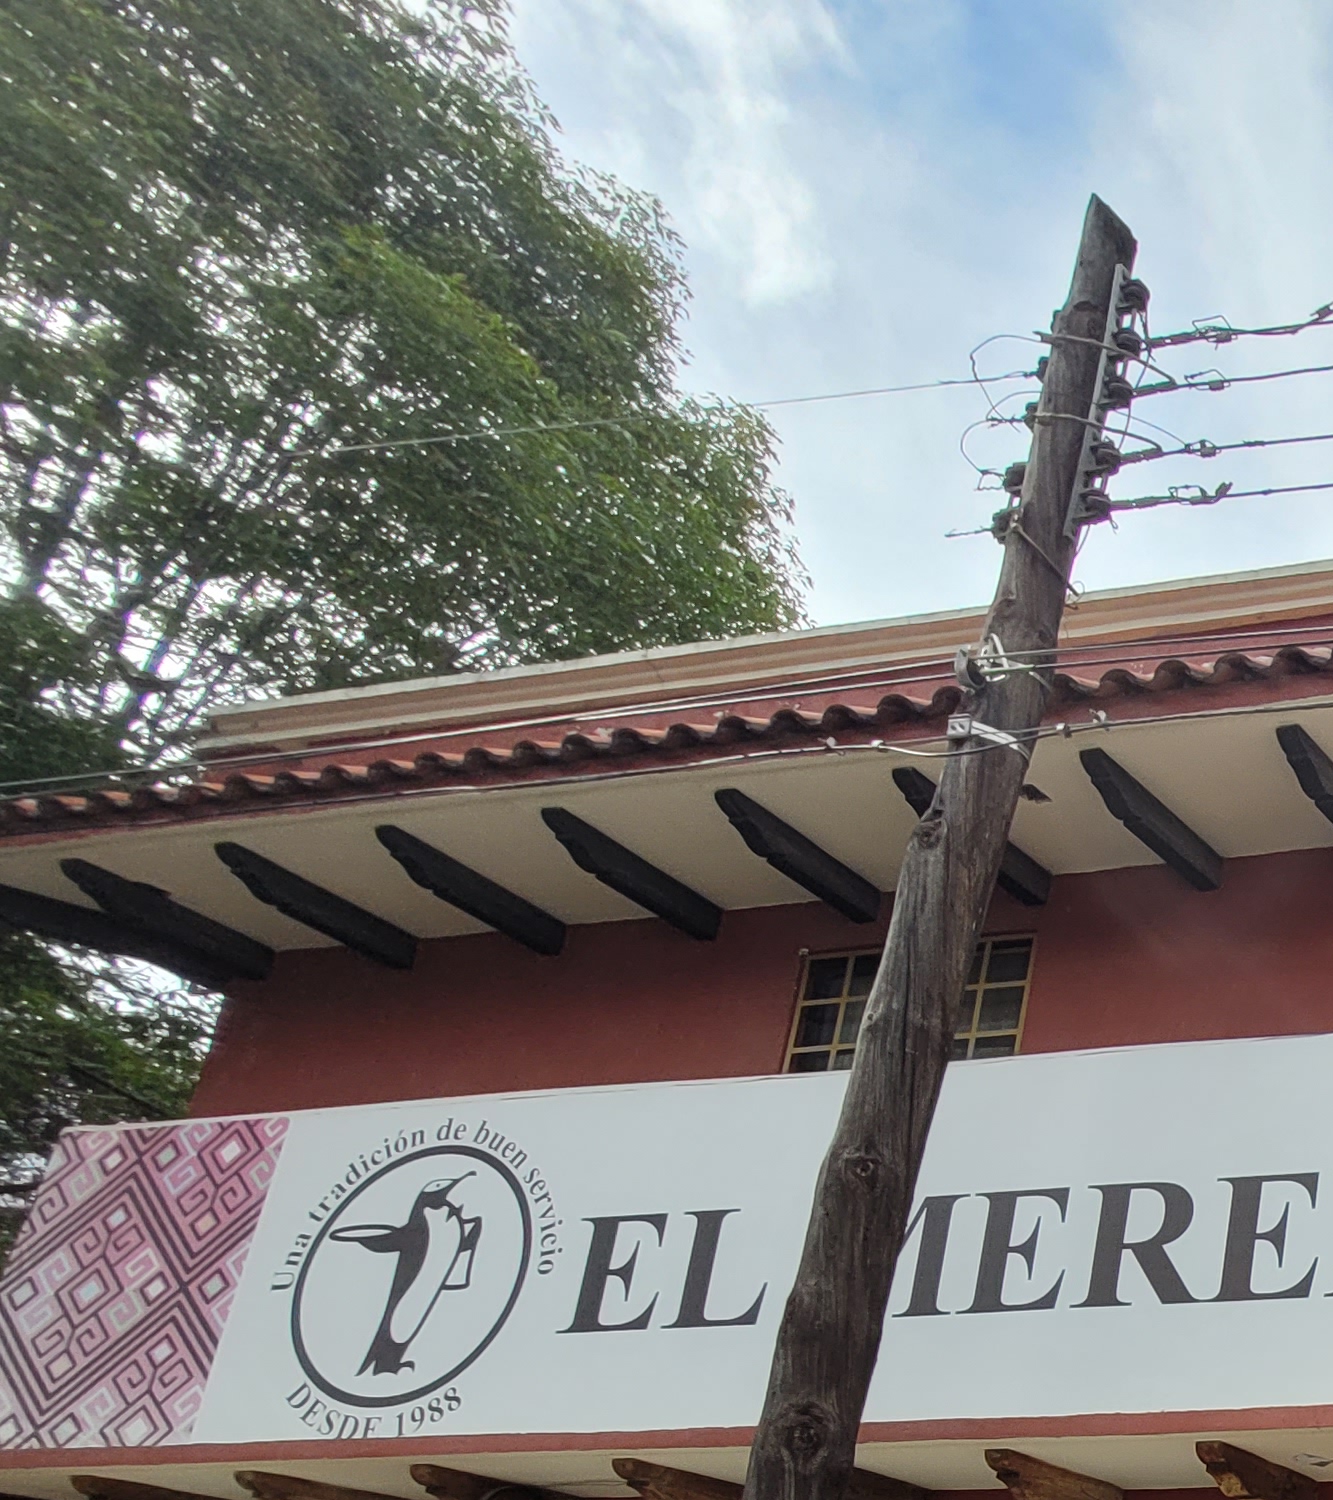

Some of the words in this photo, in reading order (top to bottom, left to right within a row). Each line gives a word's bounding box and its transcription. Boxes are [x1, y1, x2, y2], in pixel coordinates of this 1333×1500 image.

[271, 1233, 311, 1290] Una
[308, 1129, 425, 1223] tradición
[436, 1117, 467, 1141] de
[473, 1120, 528, 1169] buen
[523, 1167, 563, 1276] servicio
[556, 1208, 769, 1334] EL
[285, 1382, 382, 1439] DESDE
[395, 1386, 462, 1437] 1988
